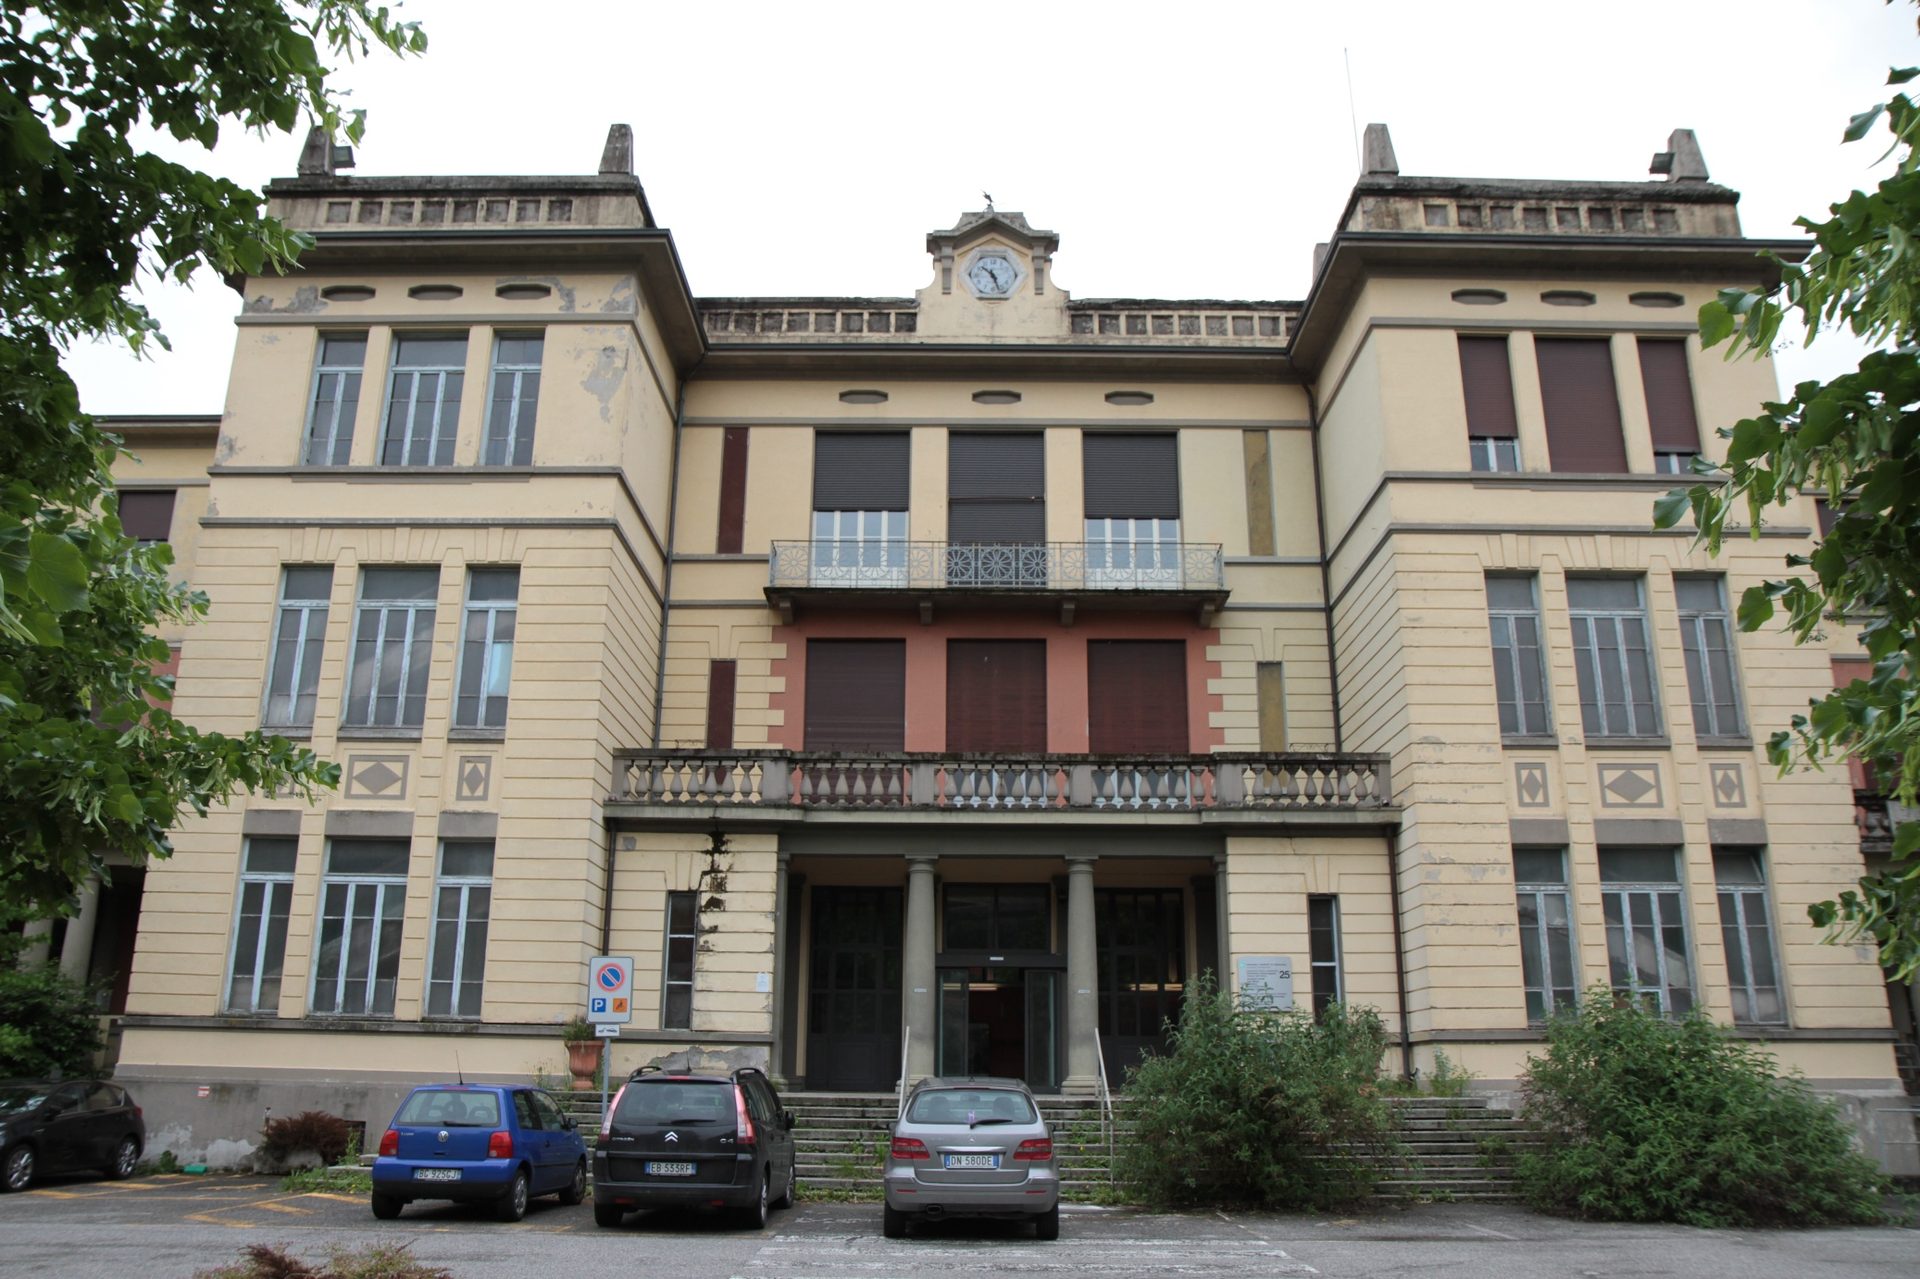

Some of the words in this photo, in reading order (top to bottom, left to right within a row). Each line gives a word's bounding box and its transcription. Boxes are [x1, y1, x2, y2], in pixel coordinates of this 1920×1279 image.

[1279, 970, 1290, 979] 25
[594, 999, 604, 1011] P
[951, 1156, 962, 1165] DN
[651, 1163, 662, 1173] EB
